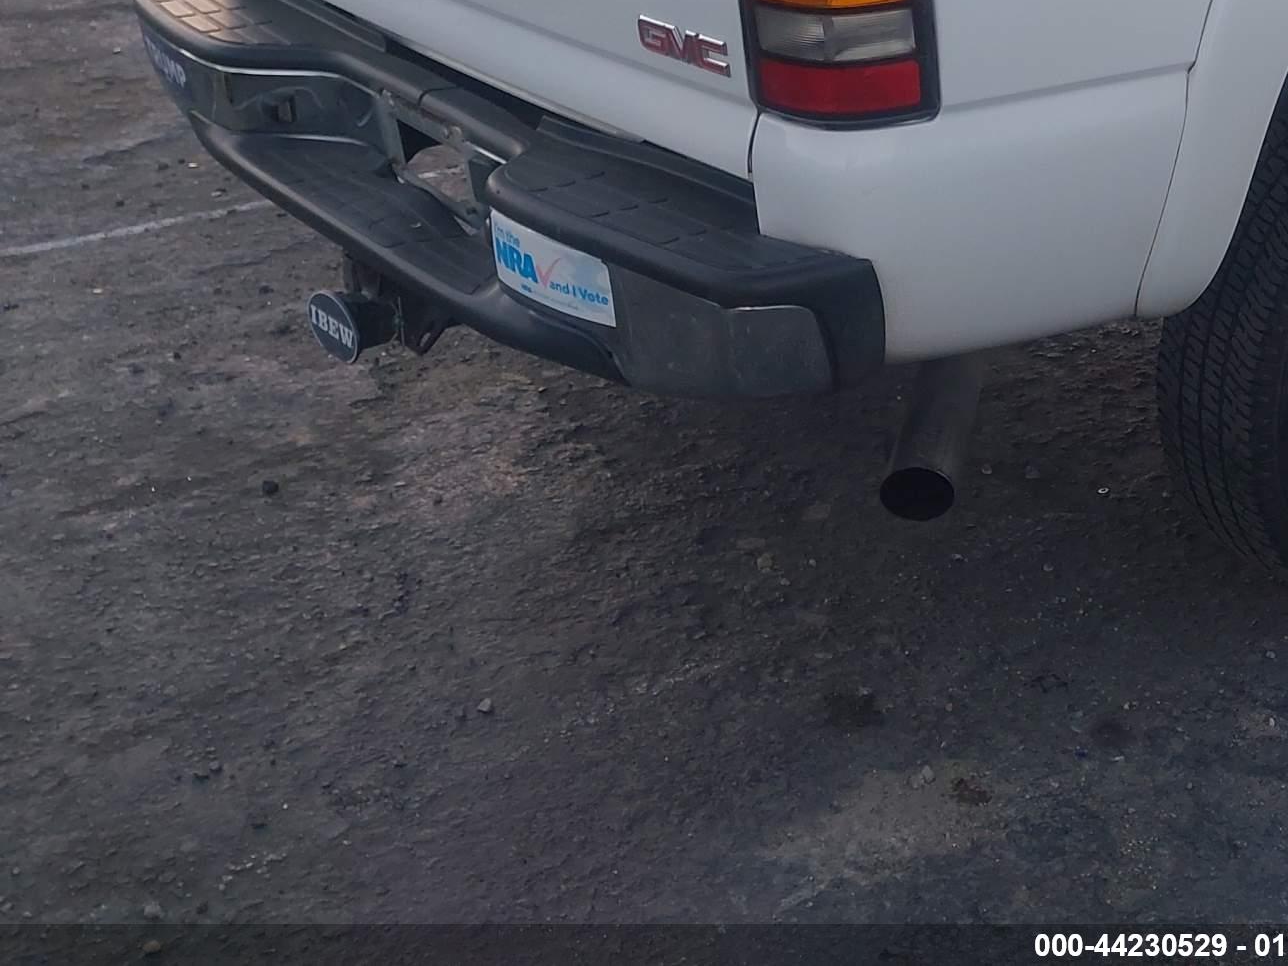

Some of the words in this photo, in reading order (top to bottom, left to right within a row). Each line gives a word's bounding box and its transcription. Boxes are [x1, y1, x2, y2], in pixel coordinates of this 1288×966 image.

[638, 14, 731, 78] GMC
[496, 236, 539, 284] NRA
[549, 280, 570, 296] and
[578, 288, 609, 307] Vote
[310, 304, 353, 349] IBEW
